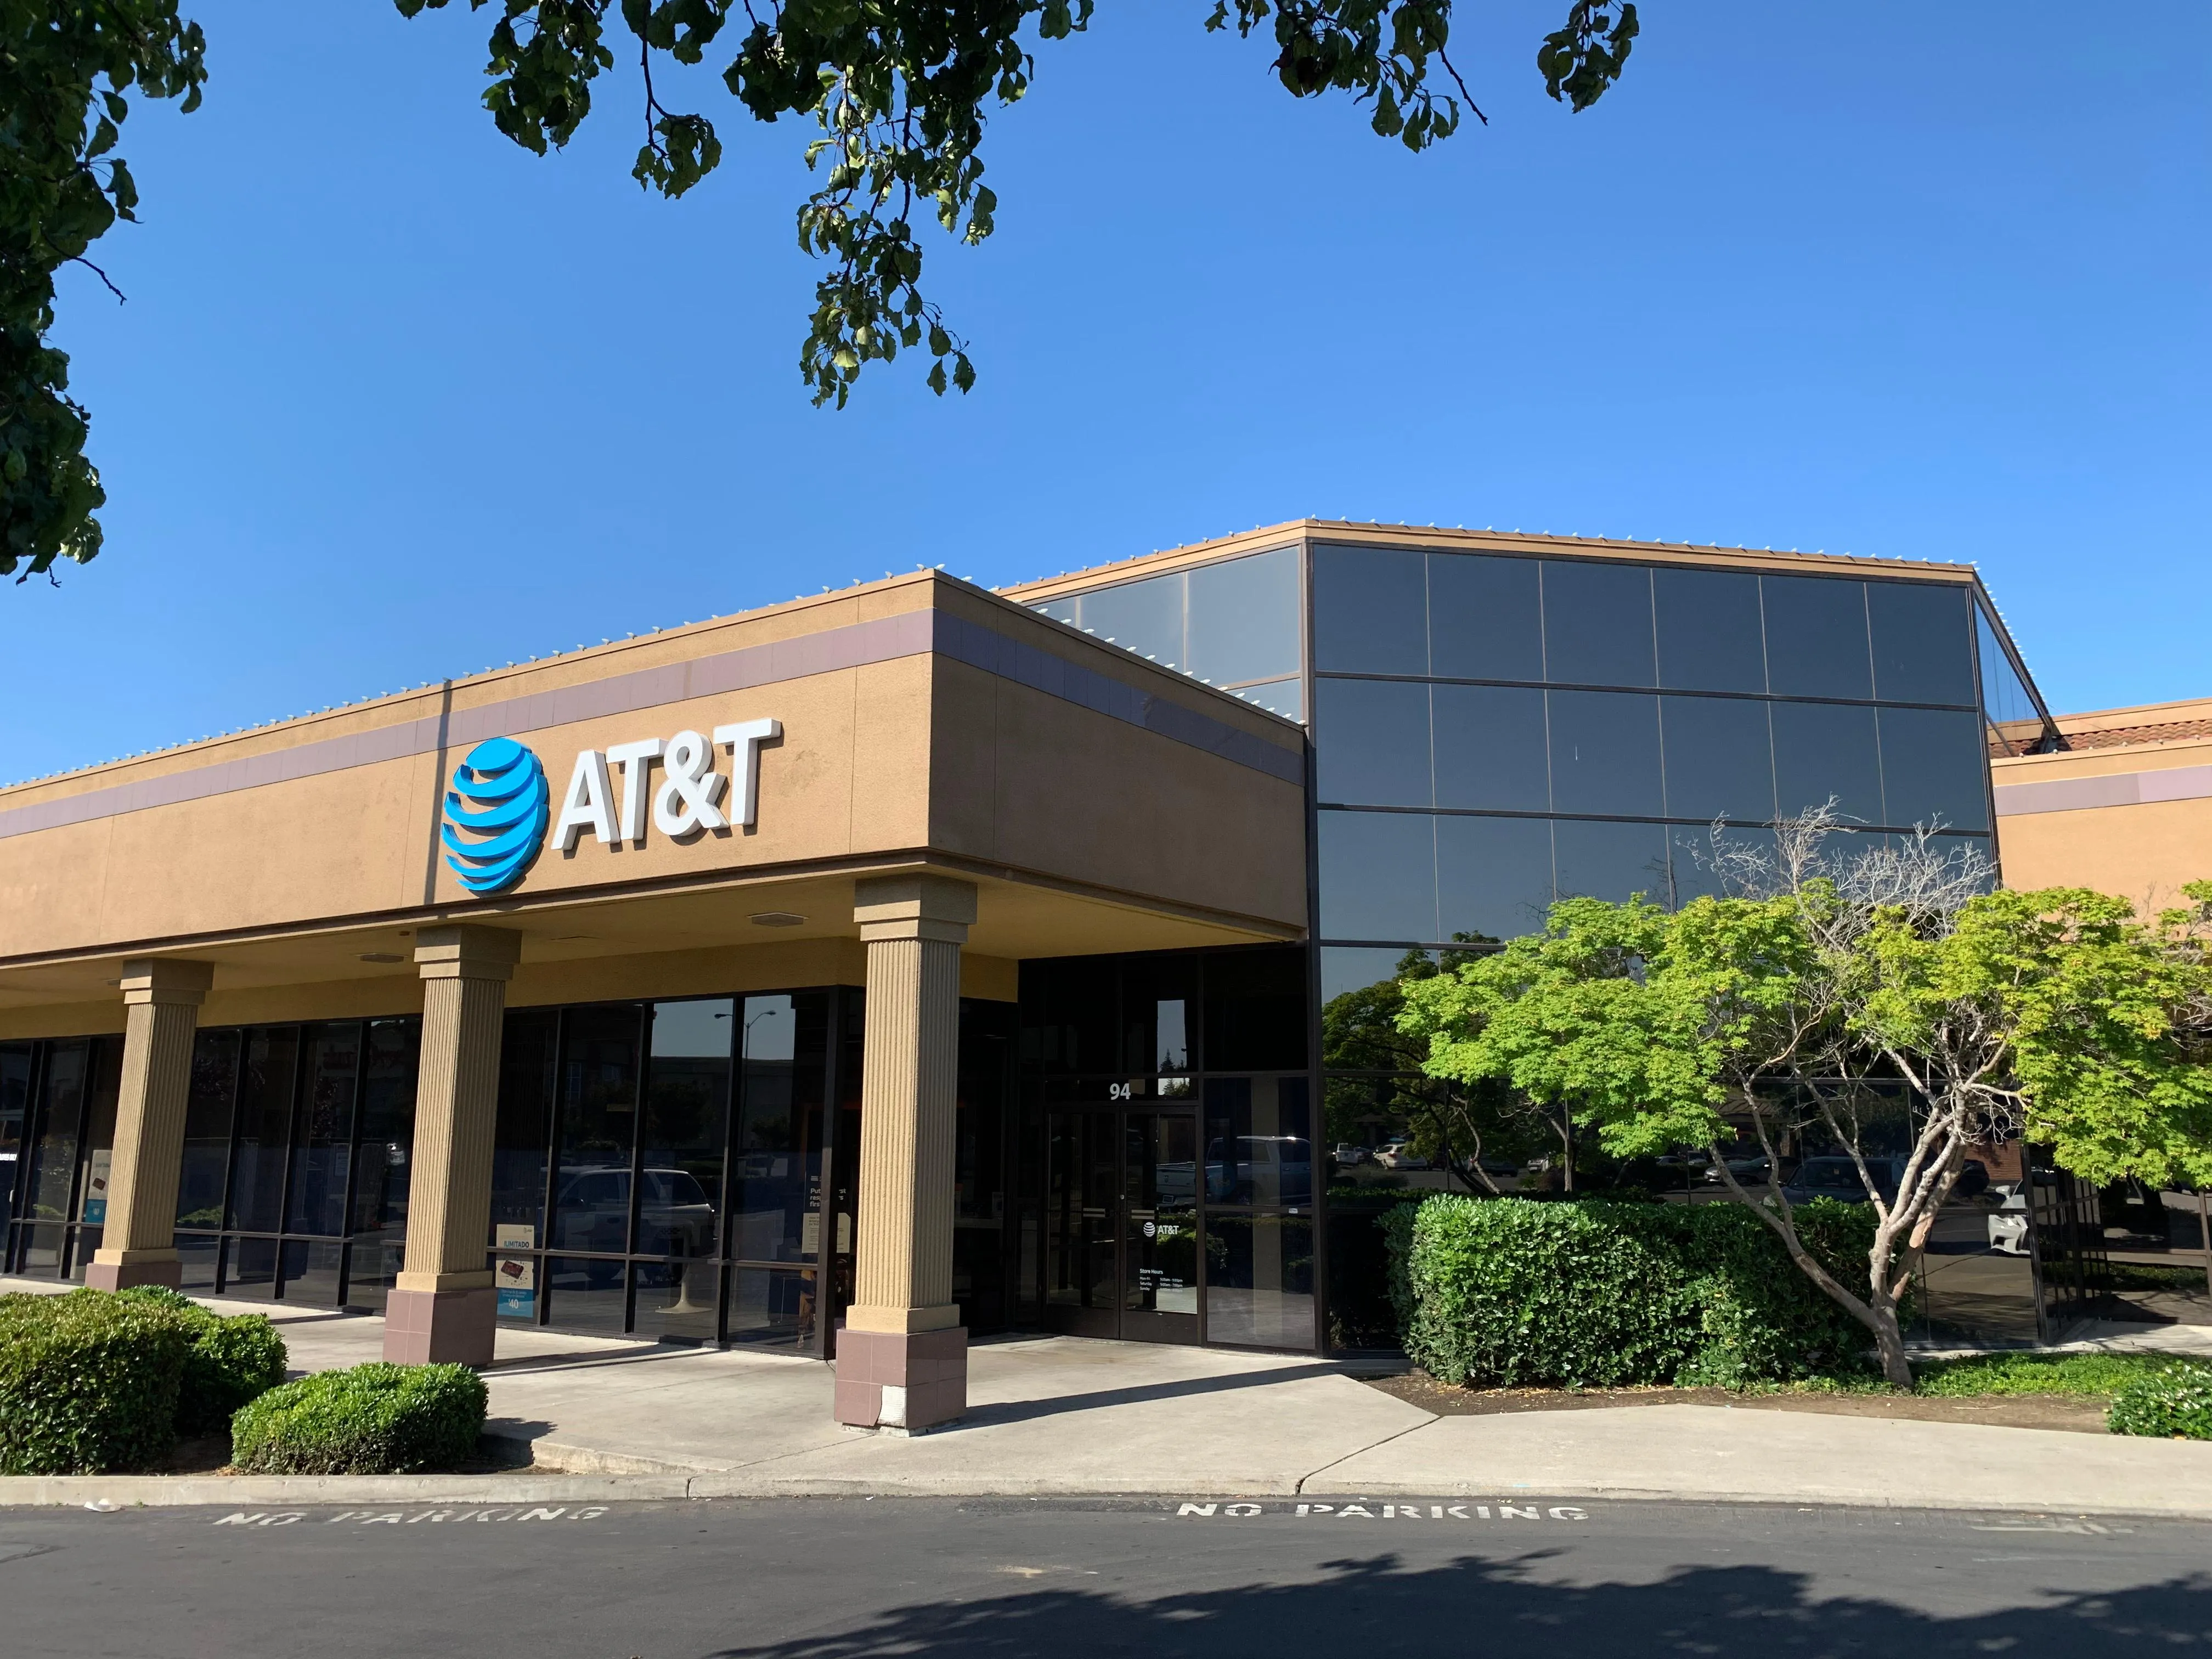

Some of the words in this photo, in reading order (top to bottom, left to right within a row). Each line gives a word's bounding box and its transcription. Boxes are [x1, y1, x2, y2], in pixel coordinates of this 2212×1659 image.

[550, 718, 781, 850] AT&T
[1109, 1083, 1131, 1100] 94
[1158, 1225, 1179, 1234] AT&T
[212, 1512, 308, 1526] NO
[327, 1507, 610, 1525] PARKING
[1176, 1503, 1262, 1517] NO
[1295, 1504, 1589, 1520] PARKING
